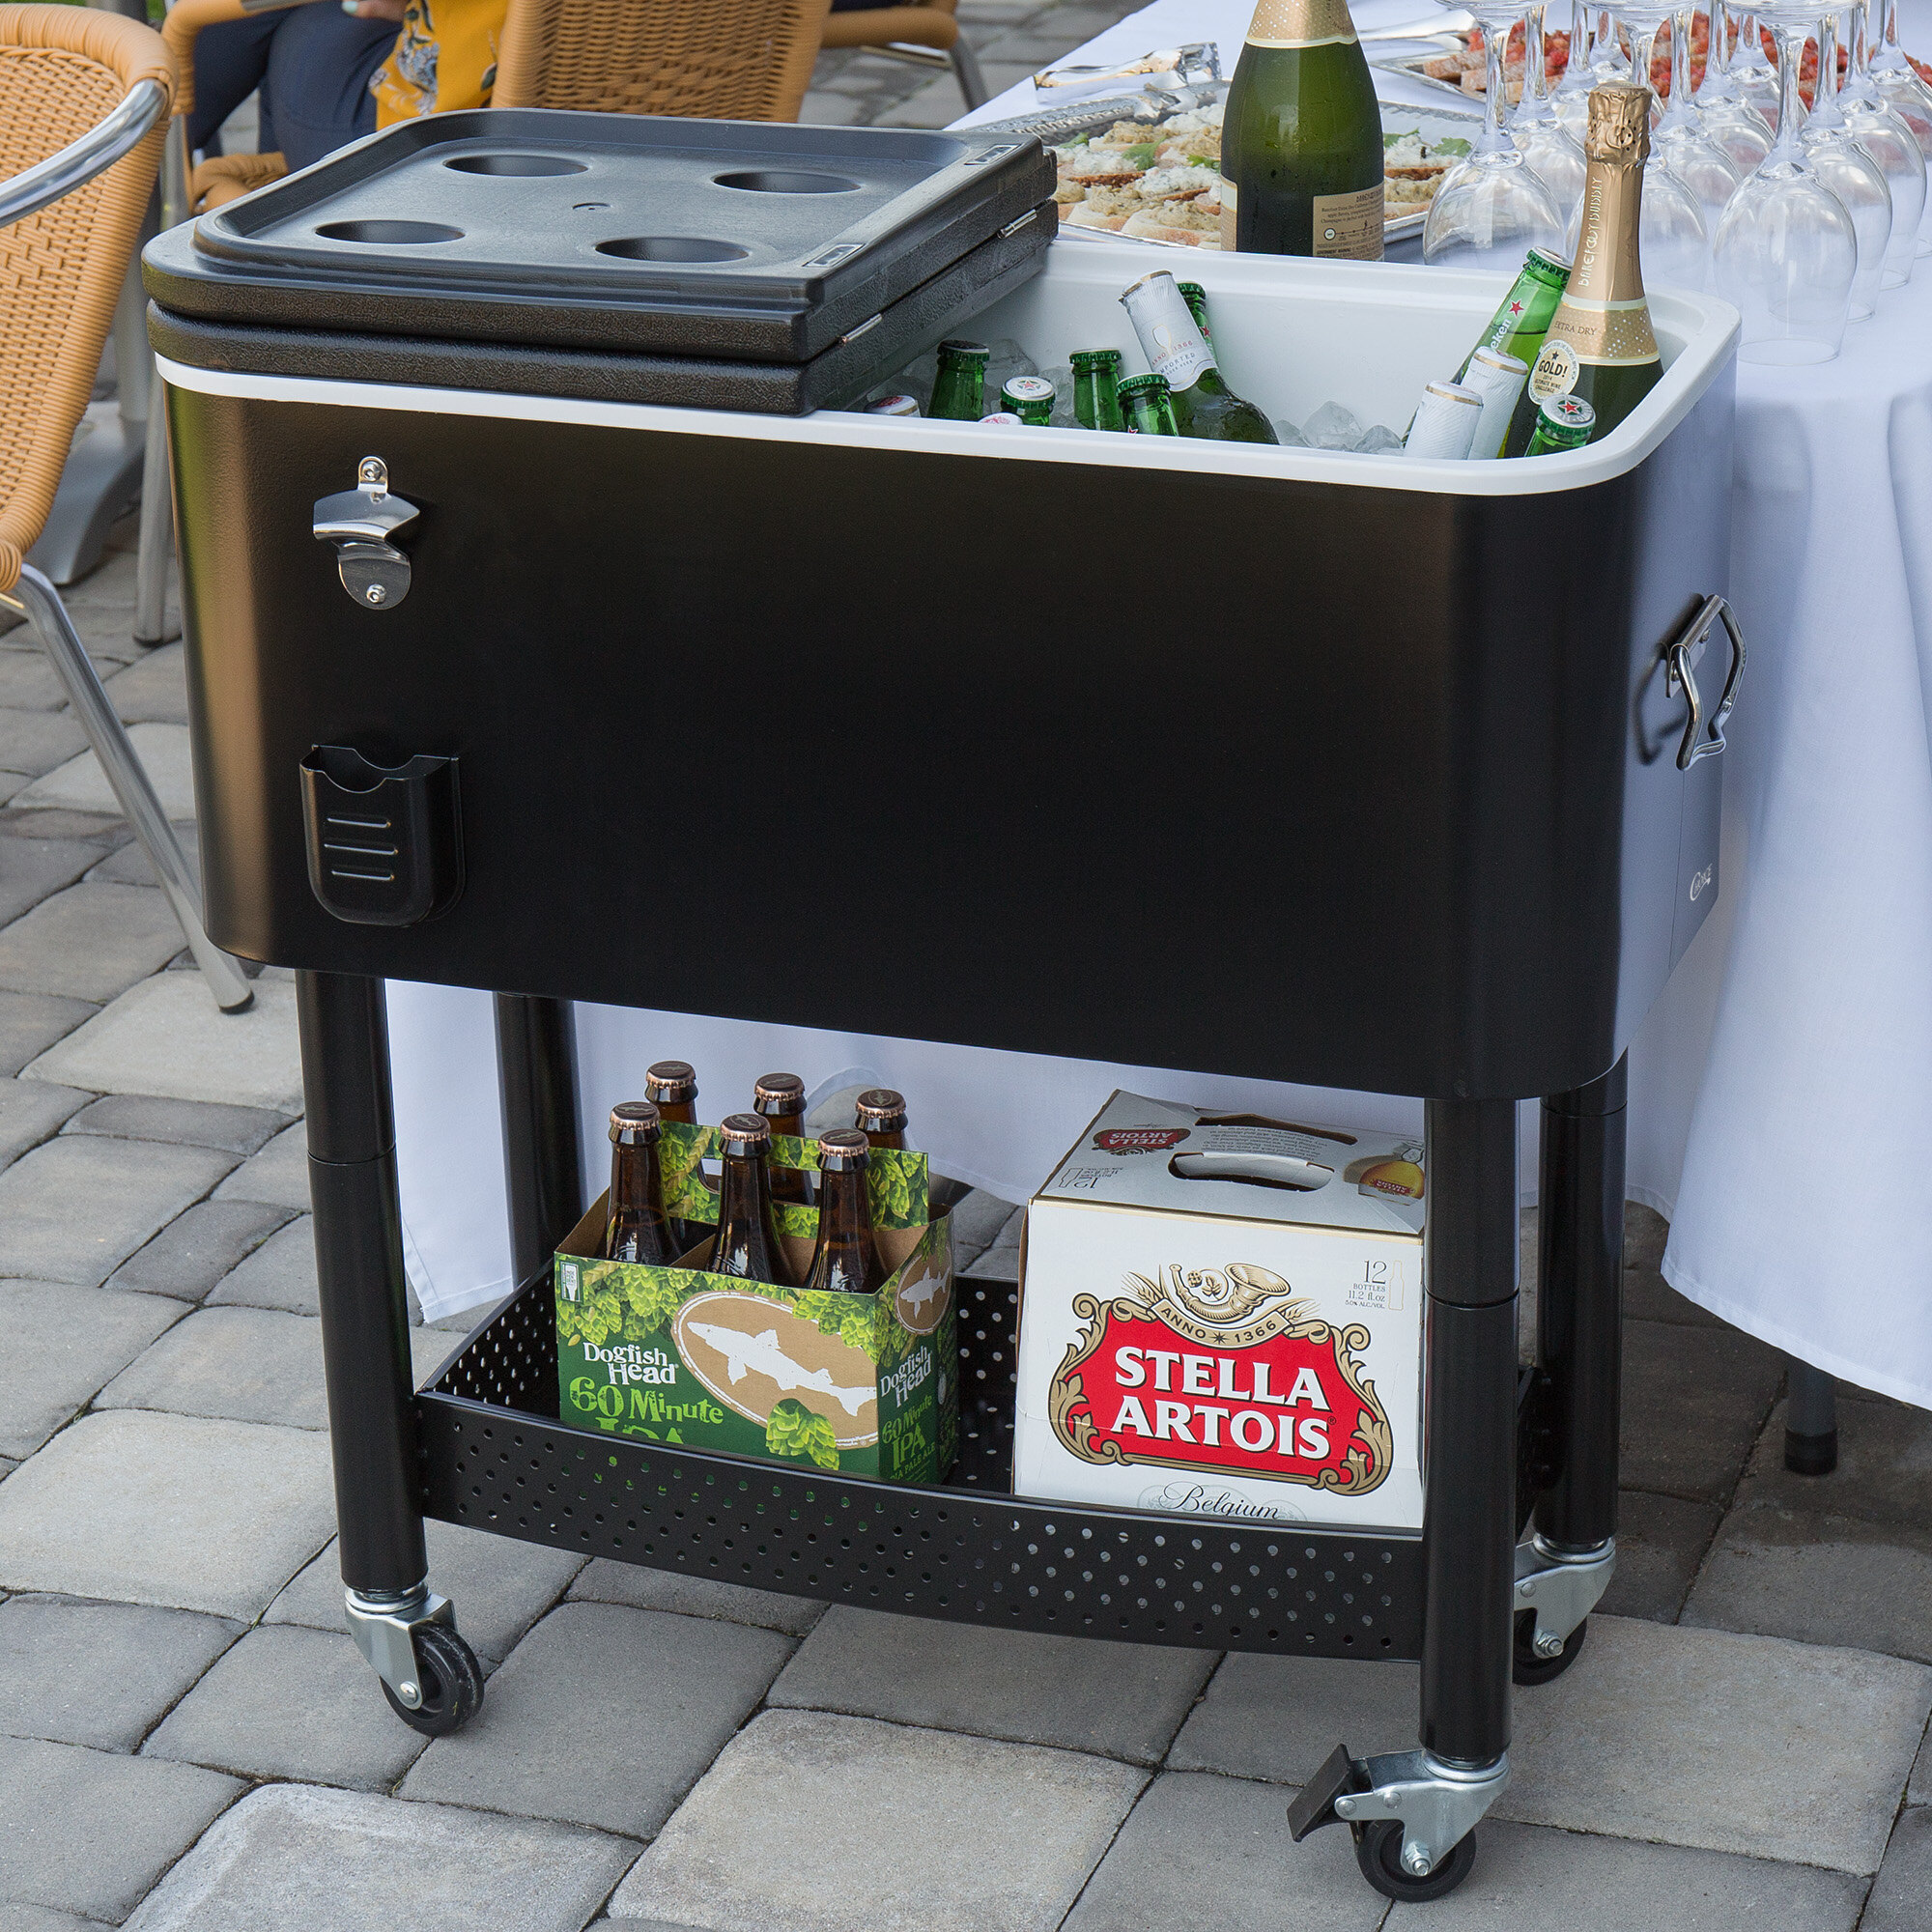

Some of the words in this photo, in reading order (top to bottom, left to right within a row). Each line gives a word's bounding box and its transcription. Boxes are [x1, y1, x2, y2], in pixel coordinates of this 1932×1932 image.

[1491, 319, 1513, 349] eken
[1554, 321, 1576, 333] EXTRA
[1577, 326, 1598, 336] DRY
[1159, 352, 1196, 373] MPORTED
[1538, 359, 1568, 378] GOLD!
[1352, 1283, 1386, 1293] BOTTLES
[1364, 1260, 1387, 1285] 12
[1349, 1290, 1365, 1300] 11.2
[1161, 1307, 1207, 1339] ANNO
[1235, 1320, 1276, 1343] 1366
[582, 1342, 668, 1367] Dogfish
[880, 1345, 928, 1398] Dogfish
[608, 1363, 677, 1385] Head
[895, 1352, 932, 1408] Head
[1115, 1346, 1332, 1412] STELLA
[569, 1376, 625, 1418] 60
[629, 1388, 724, 1425] Minute
[881, 1417, 902, 1444] 60
[902, 1394, 932, 1433] Minute
[1110, 1395, 1331, 1461] ARTOIS
[892, 1422, 926, 1471] IPA
[904, 1454, 922, 1475] PALE
[923, 1441, 936, 1460] ALE
[1158, 1481, 1280, 1520] Belgium
